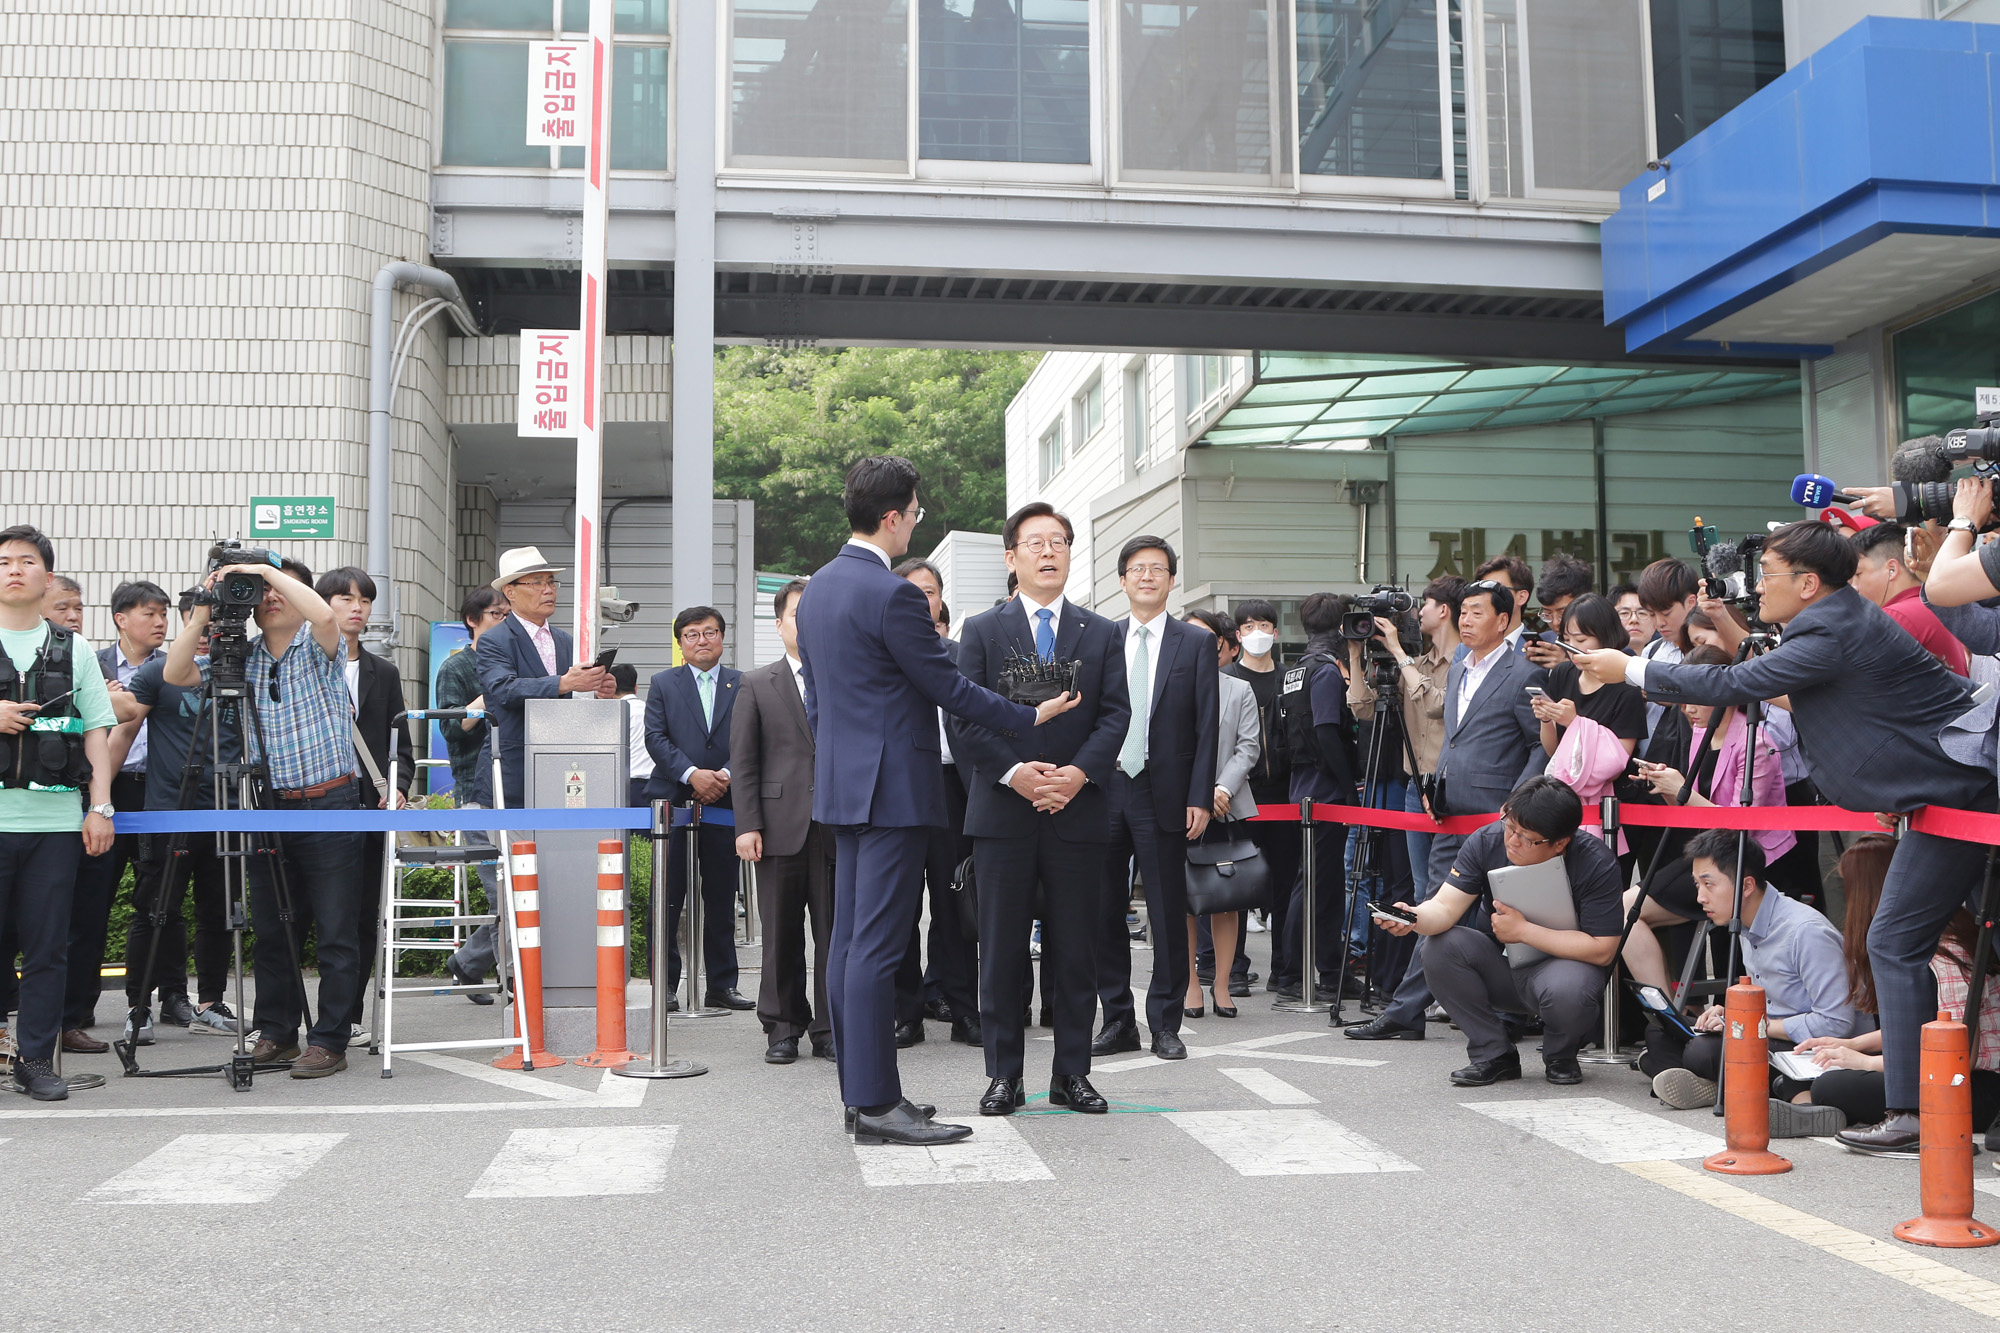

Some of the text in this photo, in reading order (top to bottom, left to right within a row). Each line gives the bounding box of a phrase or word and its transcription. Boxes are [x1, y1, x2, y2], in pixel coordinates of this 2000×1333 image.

[542, 46, 577, 139] 출입금지
[534, 335, 569, 431] 출입금지
[1980, 394, 2000, 405] 제5
[1947, 435, 1967, 450] KBS
[1802, 481, 1815, 503] YTN
[1813, 485, 1823, 504] NEWS
[283, 505, 328, 516] 흡연장소
